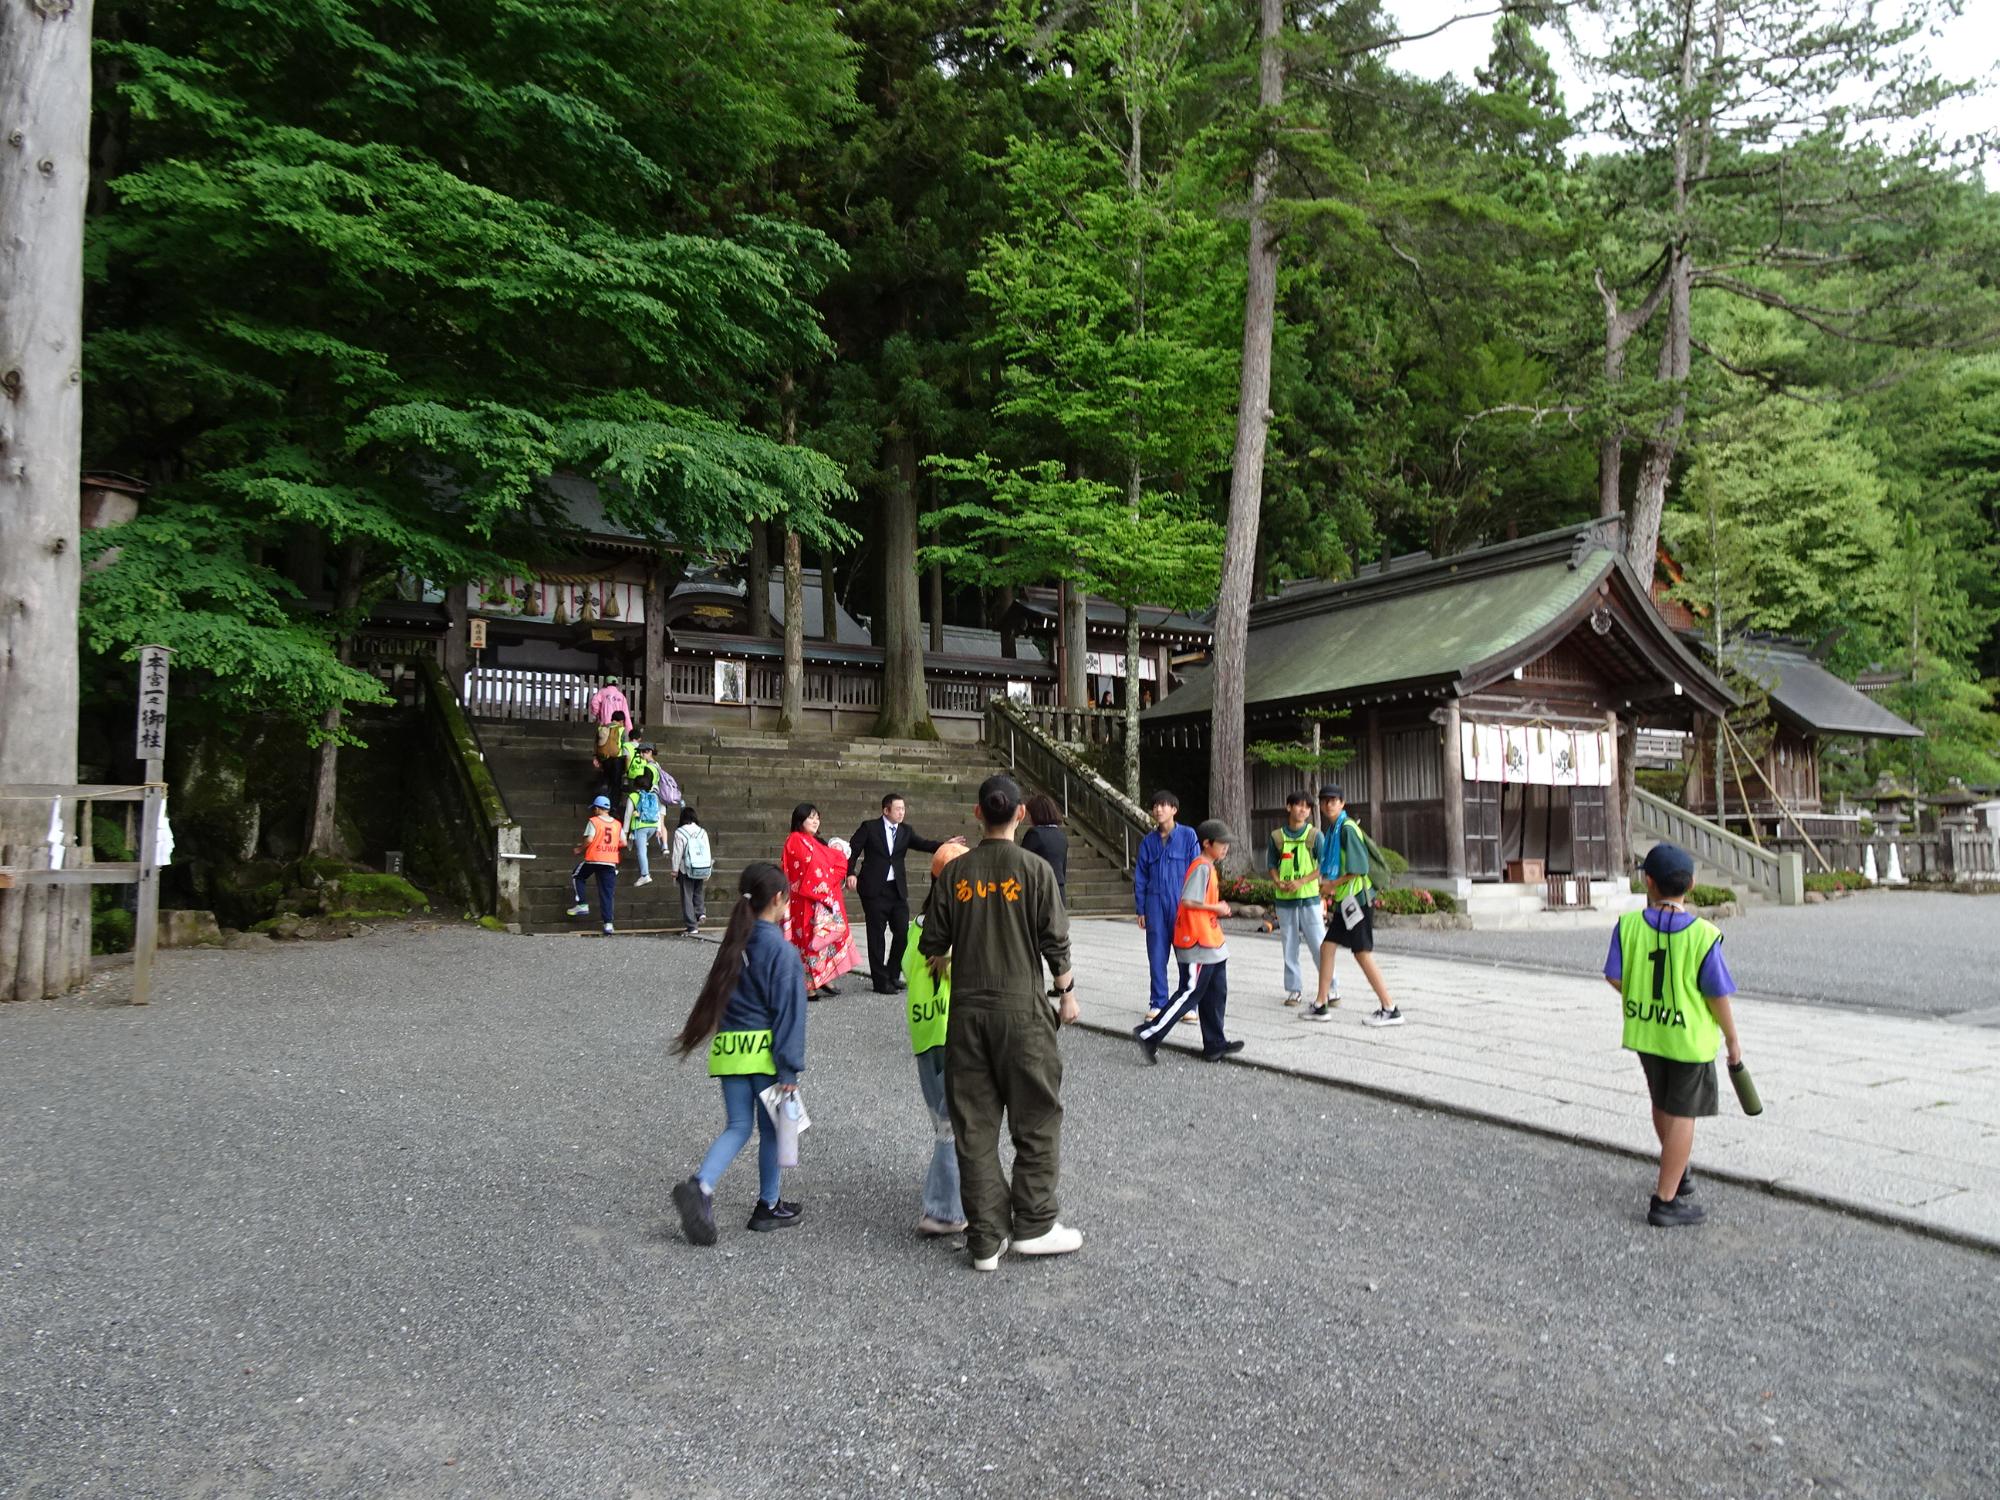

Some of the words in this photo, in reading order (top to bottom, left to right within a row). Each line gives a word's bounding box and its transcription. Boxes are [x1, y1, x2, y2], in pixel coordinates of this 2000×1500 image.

[141, 652, 166, 749] 本宮一之御柱
[604, 827, 612, 844] 5
[956, 877, 1022, 903] あいな
[1648, 948, 1667, 1001] 1
[912, 998, 947, 1023] SUW
[1625, 999, 1687, 1029] SUWA
[712, 1033, 772, 1056] SUWA
